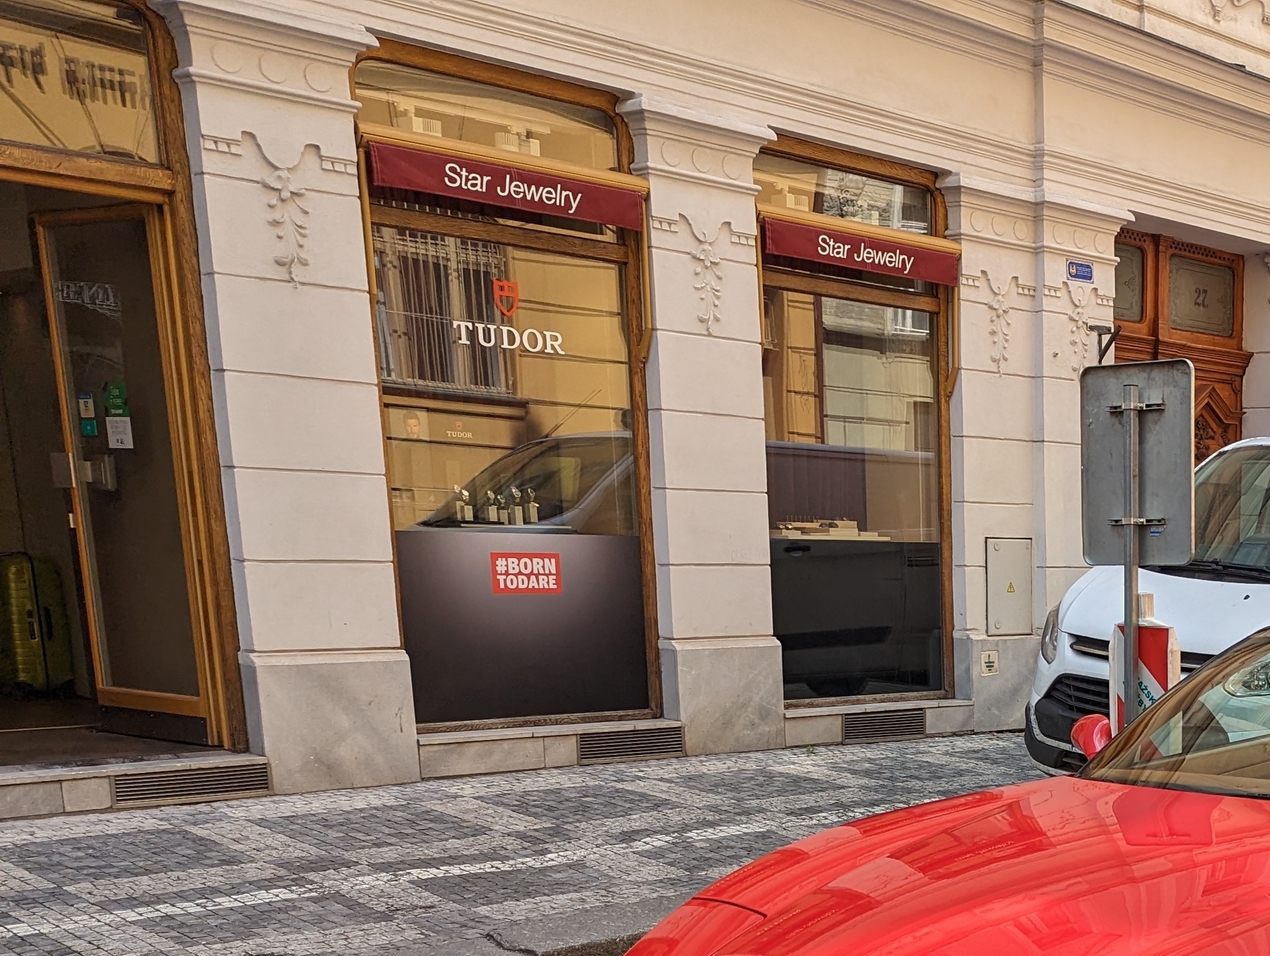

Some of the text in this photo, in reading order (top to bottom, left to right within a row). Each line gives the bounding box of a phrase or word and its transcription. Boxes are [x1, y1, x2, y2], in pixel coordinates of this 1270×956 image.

[444, 163, 582, 214] Star Jewelry
[817, 234, 914, 274] Star Jewelry
[452, 320, 565, 354] TUDOR
[496, 558, 556, 574] #BORN
[496, 575, 558, 589] TODARE
